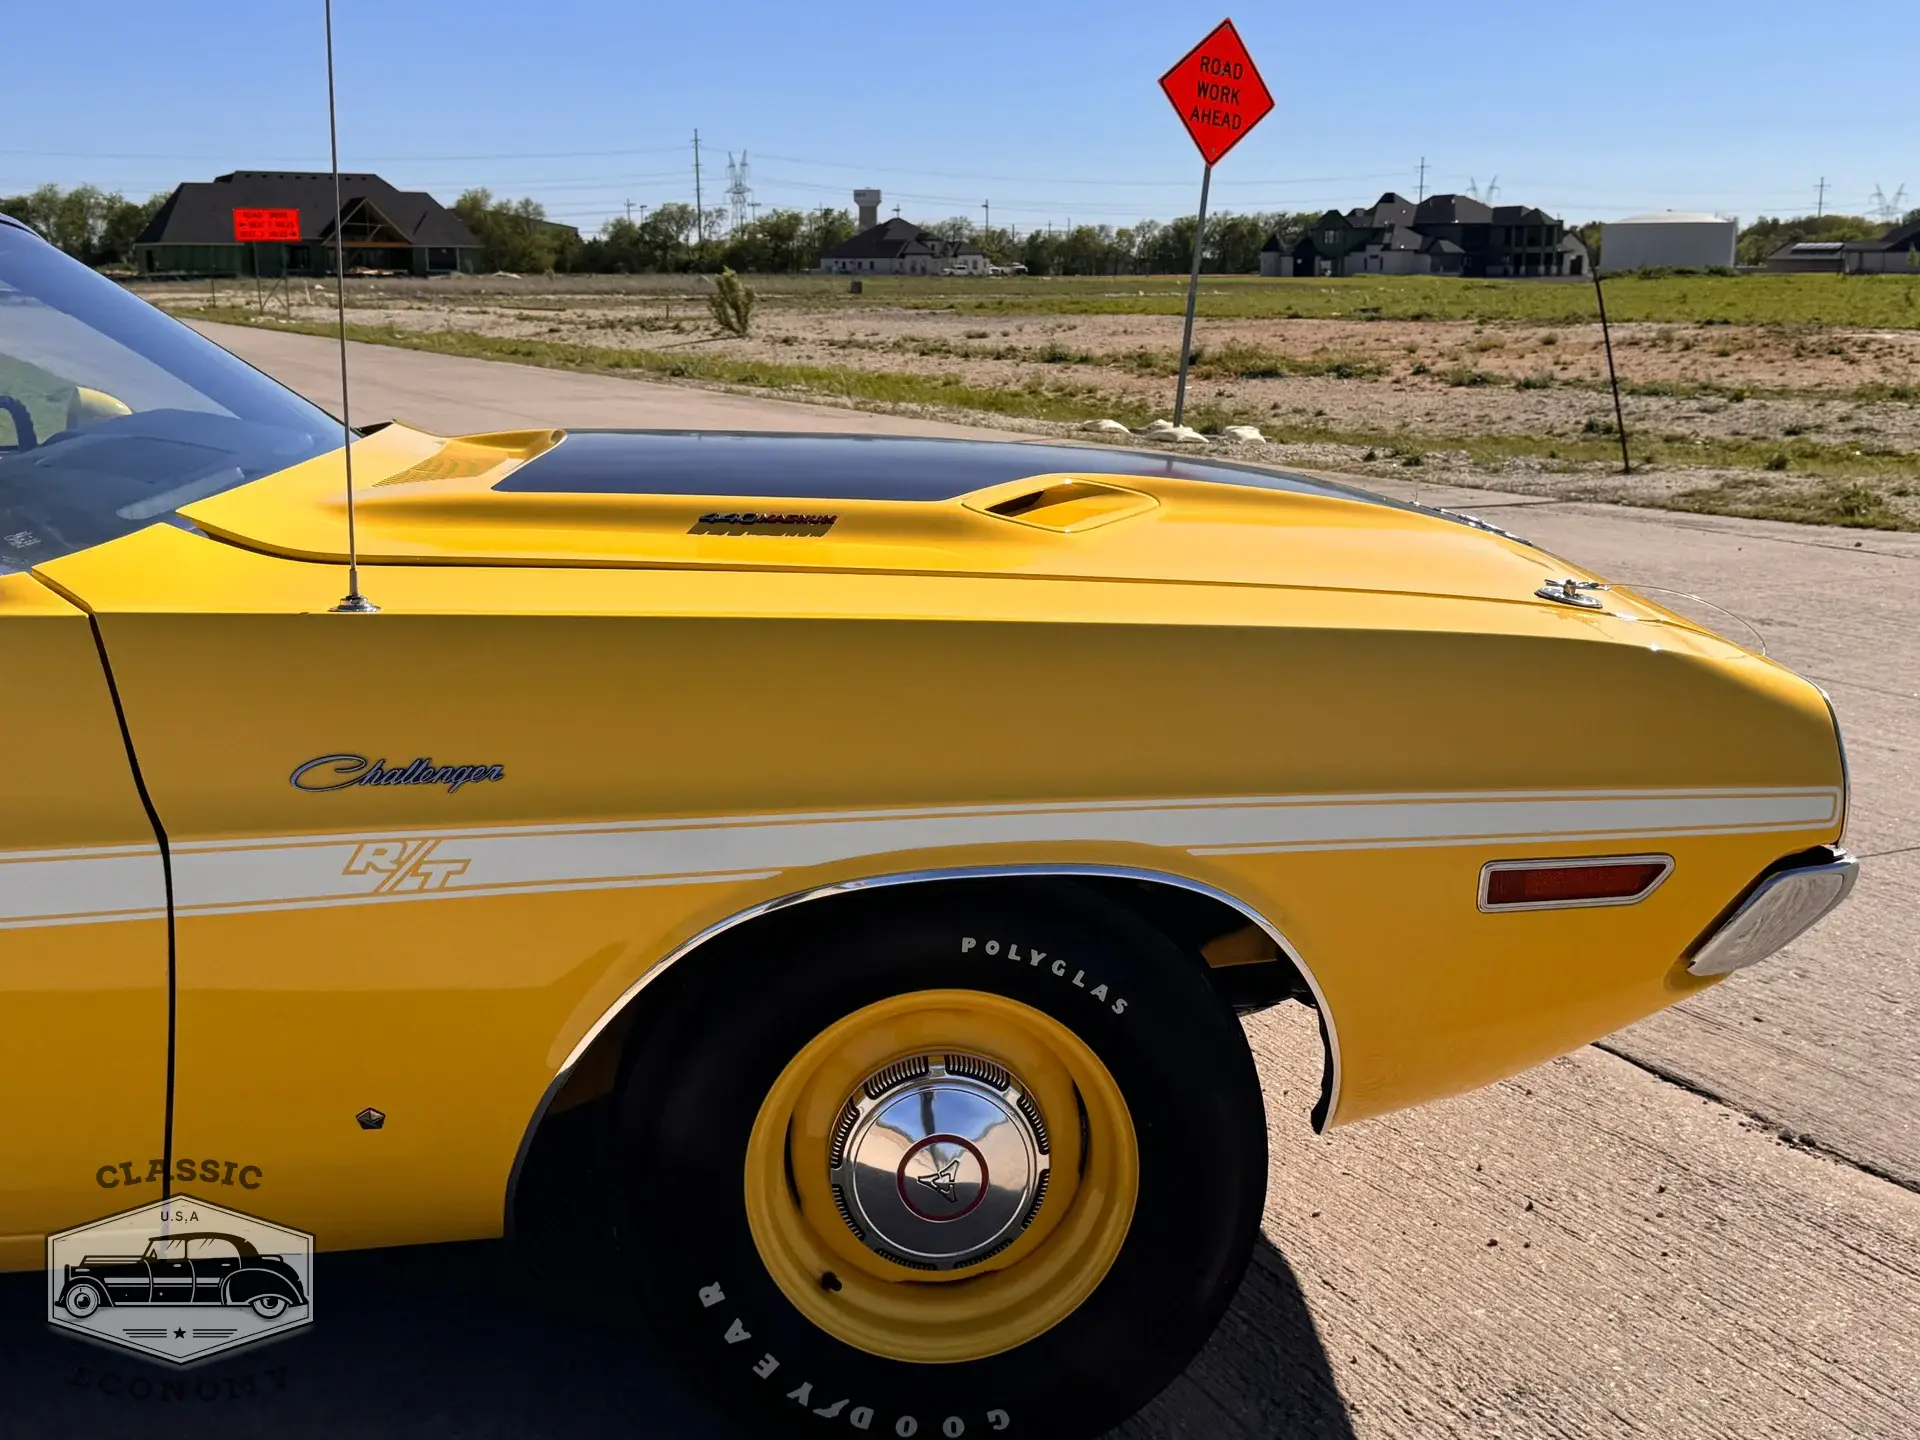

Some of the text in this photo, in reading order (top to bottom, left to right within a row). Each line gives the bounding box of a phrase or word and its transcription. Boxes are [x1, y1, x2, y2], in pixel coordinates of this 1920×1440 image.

[1200, 55, 1243, 80] ROAD
[1197, 81, 1240, 105] WORK
[1190, 106, 1242, 130] AHEAD
[699, 512, 758, 525] 440
[290, 754, 504, 793] Challenger
[342, 839, 471, 893] R/T
[961, 937, 1128, 1014] POLYGLAS
